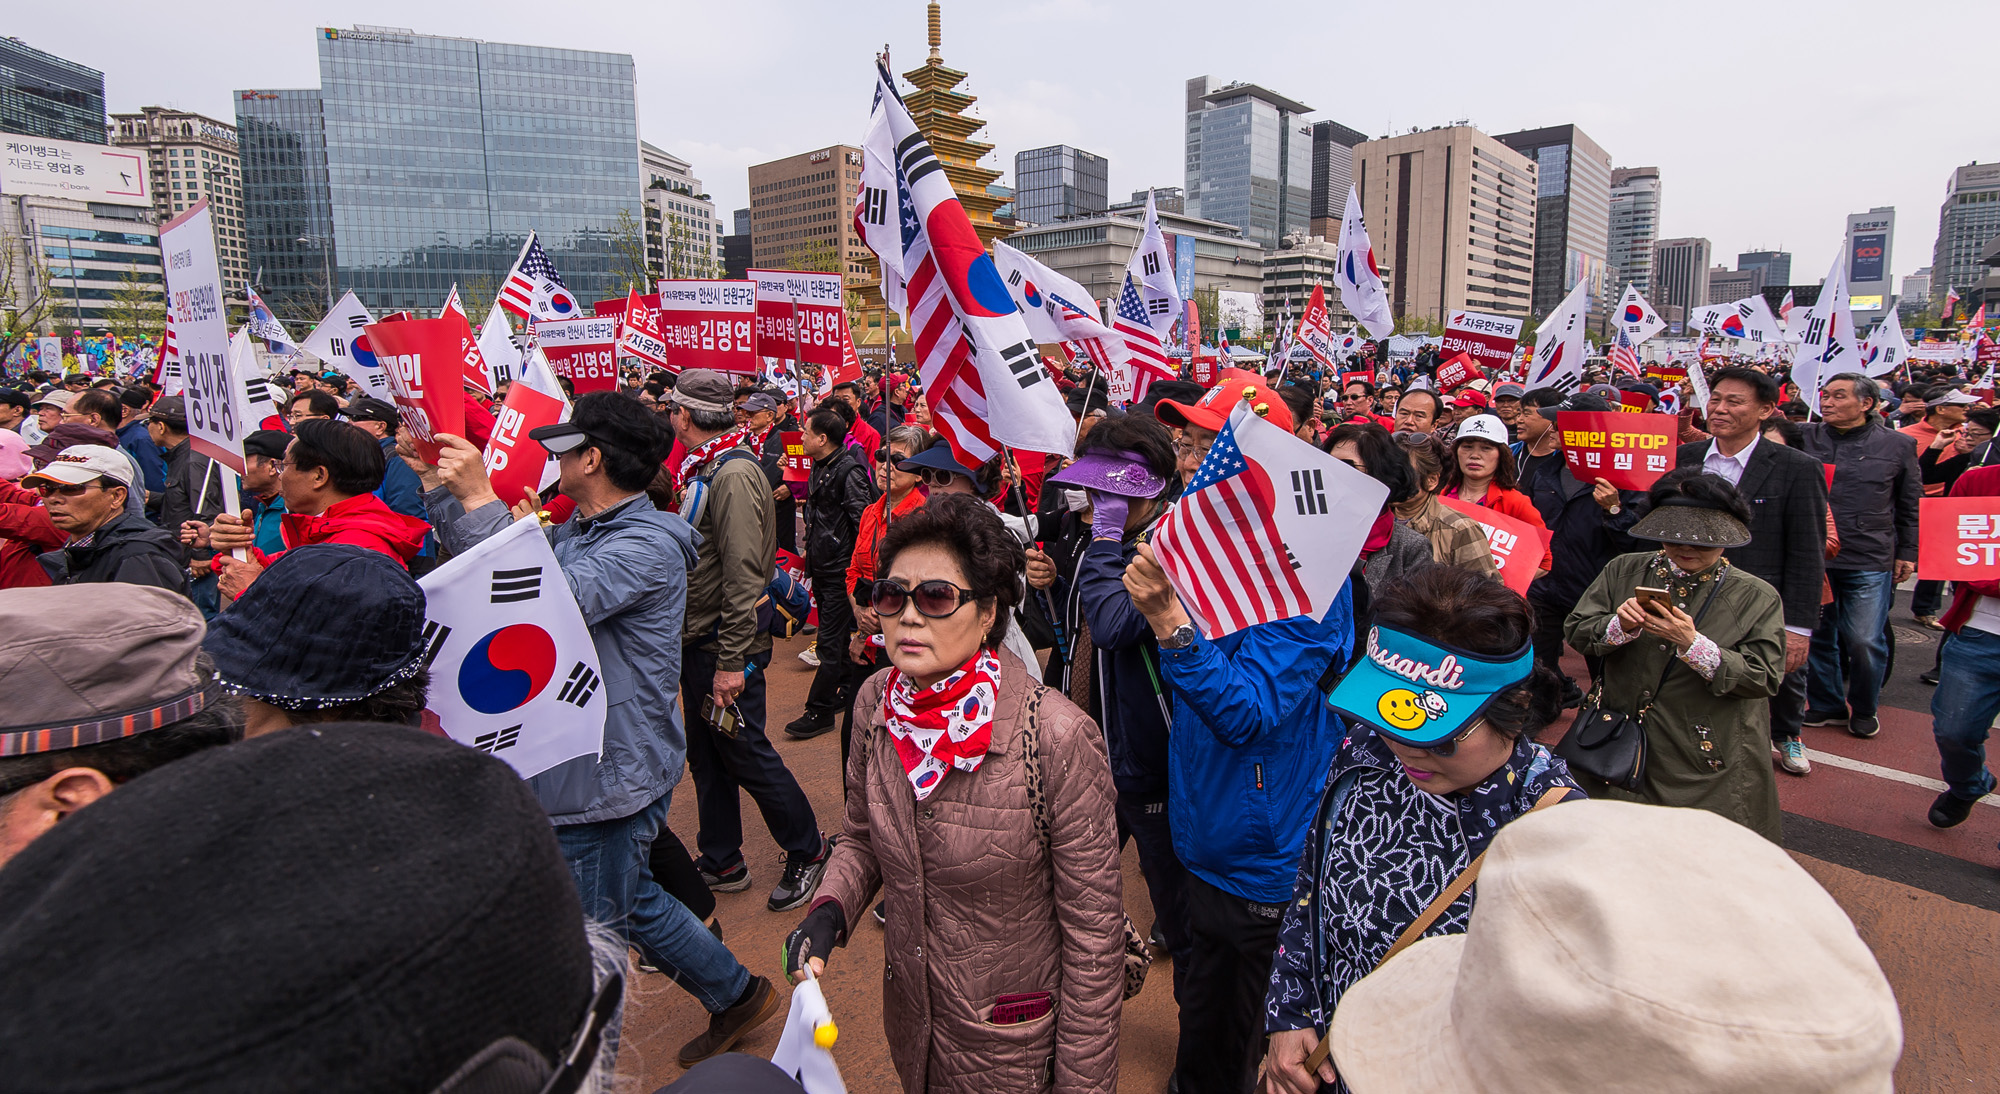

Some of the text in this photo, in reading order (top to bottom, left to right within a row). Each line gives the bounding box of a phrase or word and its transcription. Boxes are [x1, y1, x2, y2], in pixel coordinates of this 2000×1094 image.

[340, 31, 379, 41] Microsoft
[200, 124, 237, 142] SOMERS
[6, 142, 73, 160] 케이뱅크는
[8, 157, 86, 176] 지금도 영업 중
[70, 183, 91, 191] bank
[1856, 247, 1882, 258] 100
[665, 287, 754, 306] 자유한국당 안산시 단원구갑
[786, 279, 809, 298] 안산시
[810, 280, 840, 300] 단원구갑
[567, 325, 586, 340] 안산시
[588, 322, 614, 339] 단원구갑
[756, 309, 840, 347] 국회의원 김명연
[1464, 317, 1515, 335] 자유한국당
[666, 320, 751, 352] 국회의원 김명연
[571, 350, 614, 379] 김명연
[1439, 361, 1464, 380] 문재인
[1196, 374, 1210, 383] STOP
[1443, 370, 1467, 387] STOP
[185, 349, 234, 442] 홍인정
[491, 404, 526, 448] 인
[787, 444, 805, 455] 문재
[1563, 430, 1669, 450] 문재인 STOP
[1567, 450, 1667, 472] 국 민 심 판
[1956, 542, 2000, 566] ST
